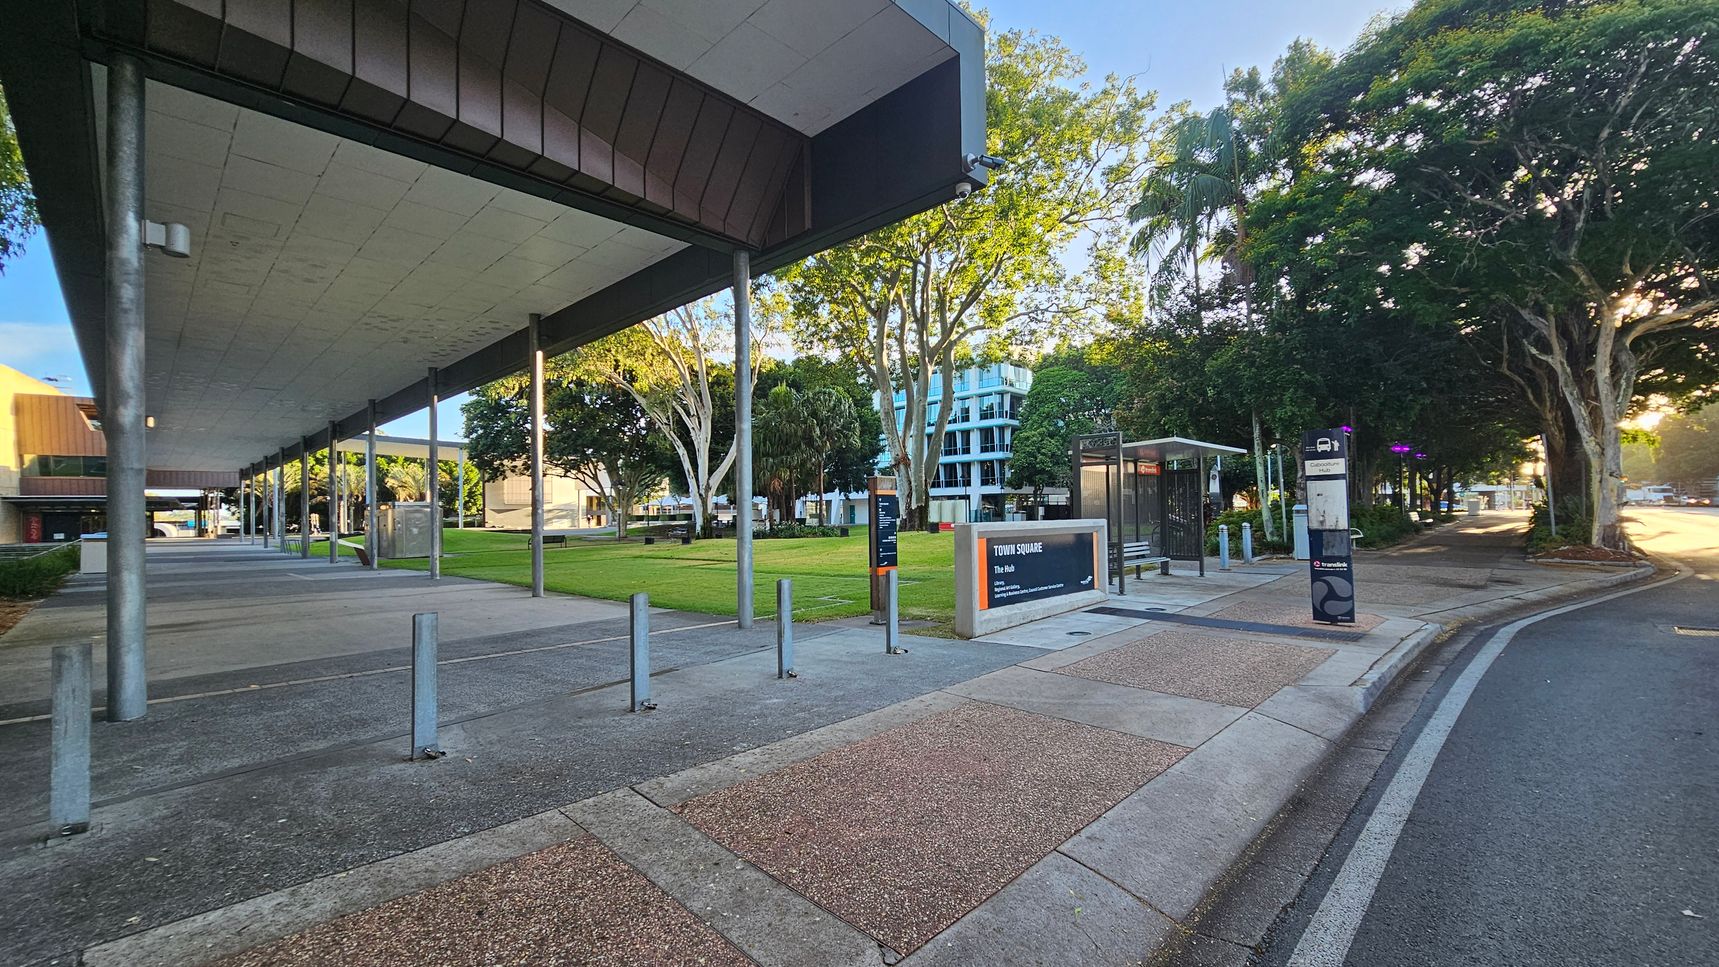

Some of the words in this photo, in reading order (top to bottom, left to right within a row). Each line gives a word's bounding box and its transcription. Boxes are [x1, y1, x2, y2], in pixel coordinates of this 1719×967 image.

[993, 544, 1016, 557] TOWN
[1016, 542, 1043, 556] SQUARE
[994, 565, 1004, 574] The
[1004, 564, 1015, 573] Hub
